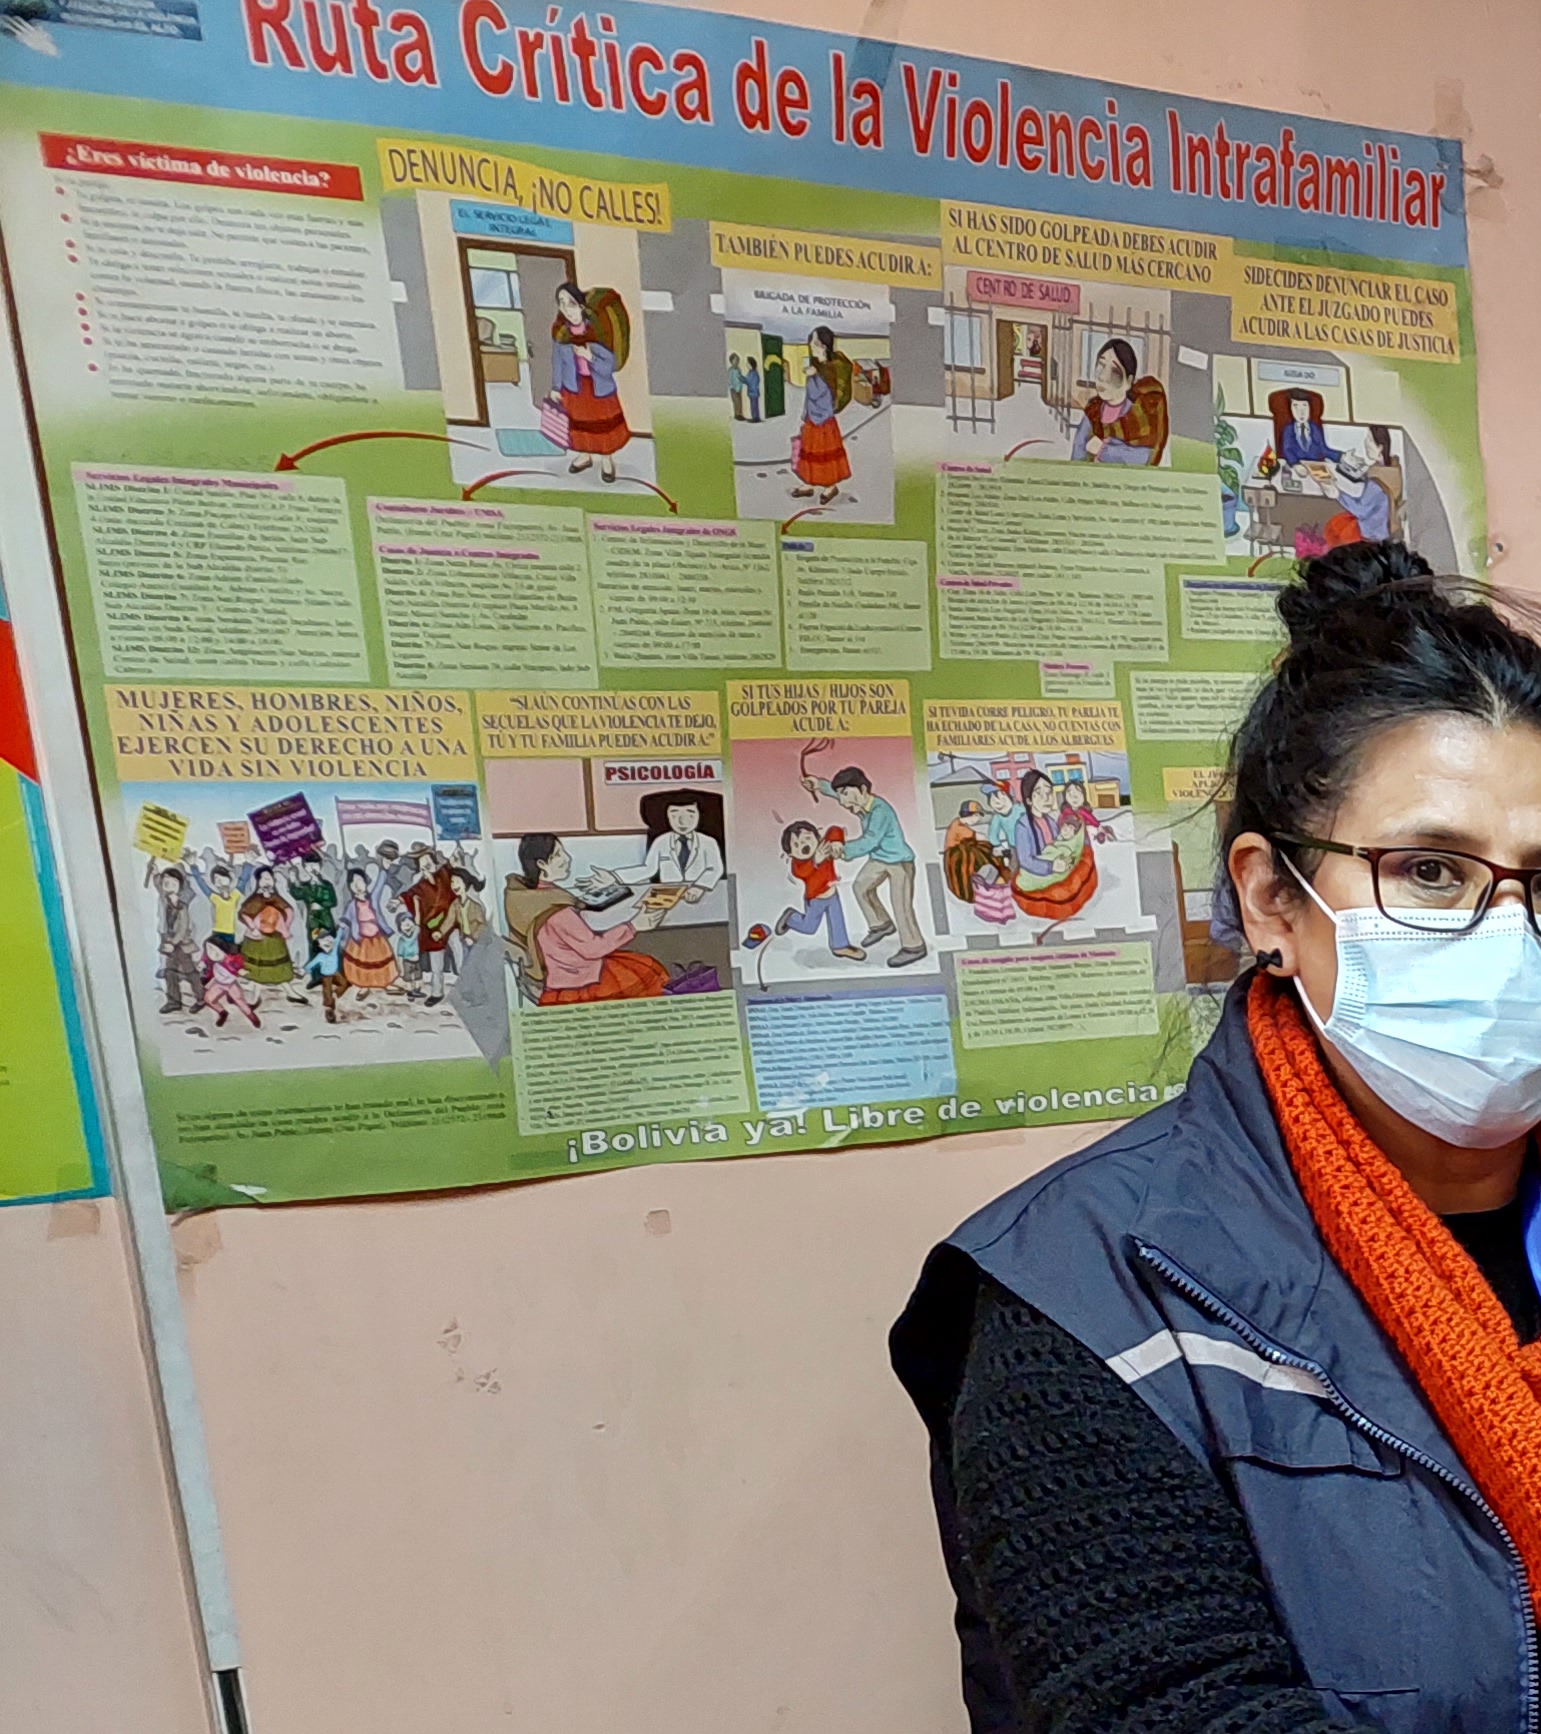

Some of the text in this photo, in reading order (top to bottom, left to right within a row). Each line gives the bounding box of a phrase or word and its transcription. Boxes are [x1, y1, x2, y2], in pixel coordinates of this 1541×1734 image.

[243, 0, 1446, 228] Ruta Crítica de la Violencia Intrafamiliar
[65, 143, 332, 189] ¿Eres víctima de violencia?
[388, 148, 664, 226] DENUNCIA, ¡NO CALLES!
[948, 208, 1218, 261] SI HAS SIDO GOLPEADA DEBES ACUDIR
[715, 232, 790, 260] TAMBIÉN
[794, 242, 854, 268] PUEDES
[857, 251, 915, 275] ACUDIR
[953, 236, 974, 254] AL
[975, 238, 1038, 264] CENTRO
[1042, 246, 1062, 265] DE
[1065, 249, 1112, 271] SALUD
[1148, 258, 1212, 284] CERCANO
[1020, 282, 1034, 300] DE
[1038, 284, 1072, 304] SALUD
[1315, 274, 1391, 301] DENUNCIAR
[1394, 284, 1412, 303] EL
[1414, 286, 1449, 307] CASO
[1260, 293, 1435, 329] ANTE EL JUZGADO PUEDES
[1239, 316, 1291, 338] ACUDIR
[1304, 322, 1329, 342] LAS
[1331, 325, 1374, 347] CASAS
[1377, 330, 1395, 348] DE
[1397, 331, 1456, 356] JUSTICIA
[115, 690, 464, 716] MUJERES, HOMBRES, NIÑOS,
[742, 684, 754, 700] SI
[757, 684, 782, 700] TUS
[784, 683, 821, 700] HIJAS
[829, 683, 867, 699] HIJOS
[868, 683, 895, 698] SON
[138, 709, 444, 734] NIÑAS Y ADOLESCENTES
[730, 699, 907, 718] GOLPEADOS POR TU PAREJA
[791, 717, 834, 732] ACUDE
[117, 735, 469, 756] EJERCEN SU DERECHO A UNA
[168, 758, 428, 778] VIDA SIN VIOLENCIA
[604, 762, 715, 781] PSICOLOGÍA
[567, 1081, 1158, 1164] ¡Bolivia ya! Libre de violencia
